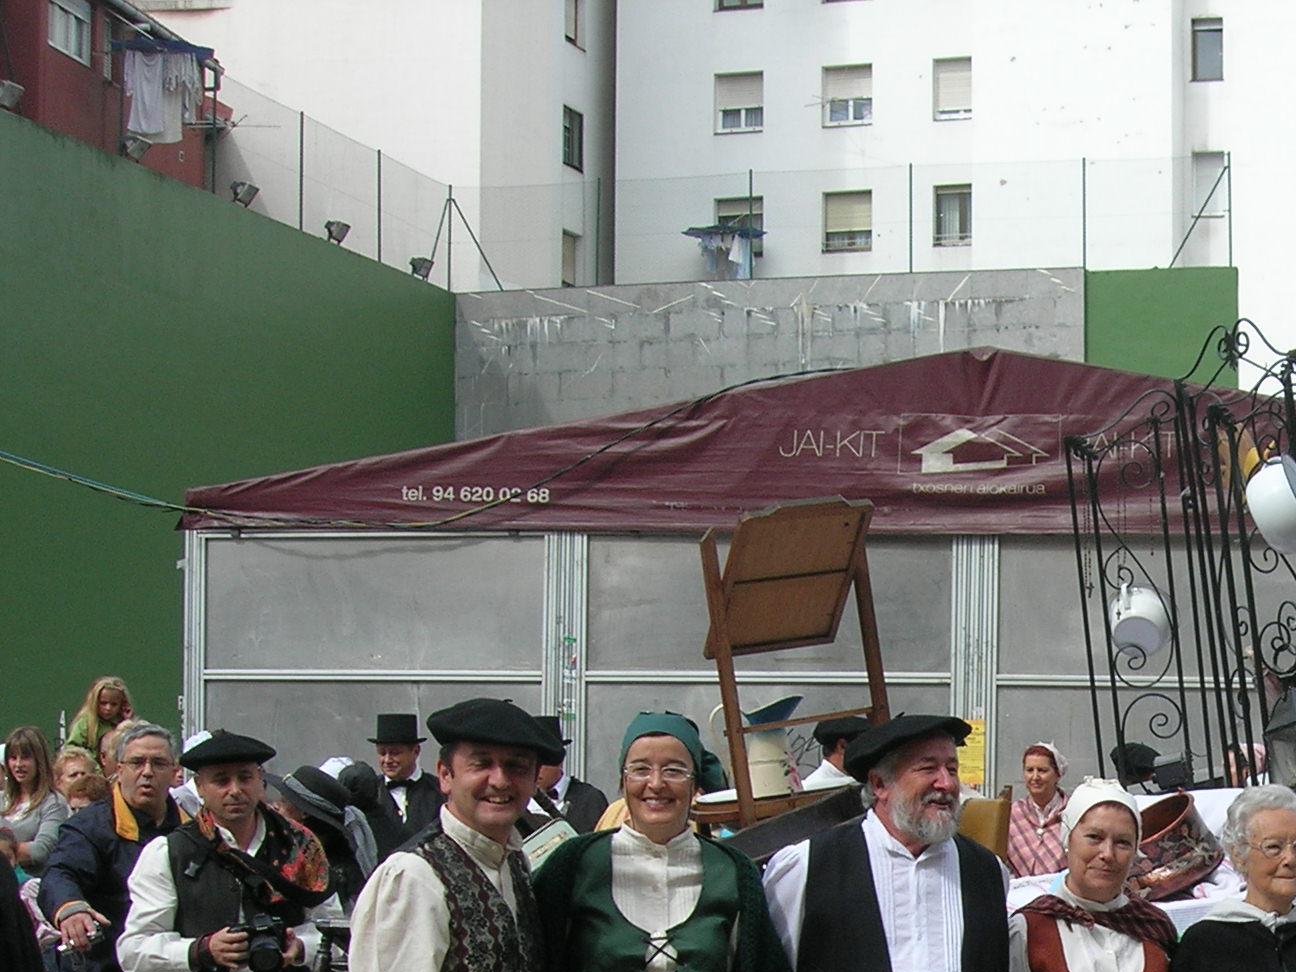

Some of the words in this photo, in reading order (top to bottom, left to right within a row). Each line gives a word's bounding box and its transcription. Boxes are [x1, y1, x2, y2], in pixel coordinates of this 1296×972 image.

[778, 428, 886, 458] JAI-KIT
[401, 485, 427, 501] tel.
[432, 486, 455, 501] 94
[459, 486, 494, 503] 620
[526, 488, 550, 503] 68
